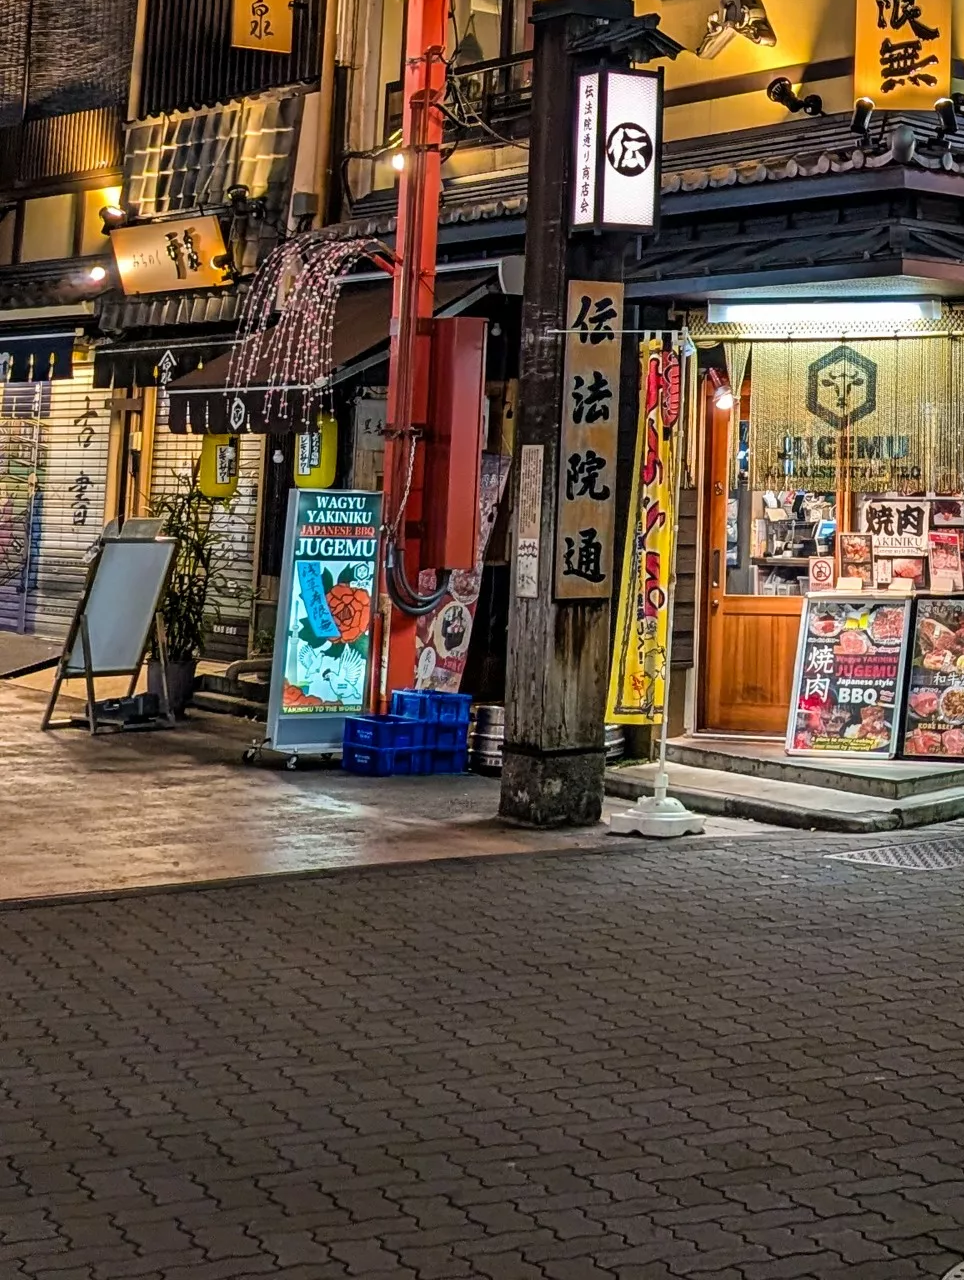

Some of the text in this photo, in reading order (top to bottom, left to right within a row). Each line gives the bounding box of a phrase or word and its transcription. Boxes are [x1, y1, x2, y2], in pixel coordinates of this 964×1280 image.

[580, 84, 595, 214] 伝法院通り商店会
[607, 126, 648, 171] 伝
[563, 295, 618, 584] 伝法院通
[300, 436, 308, 474] レモンサワー
[316, 496, 367, 510] WAGYU
[307, 510, 373, 525] YAKINIKU
[865, 503, 926, 537] 焼肉
[299, 524, 376, 537] JAPANESE BBQ
[295, 538, 377, 557] JUGEMU
[874, 537, 923, 547] AKINIKU
[805, 645, 834, 703] 焼肉
[835, 664, 896, 678] JUGEMU
[836, 678, 894, 688] Japanese style
[838, 687, 878, 706] BBQ
